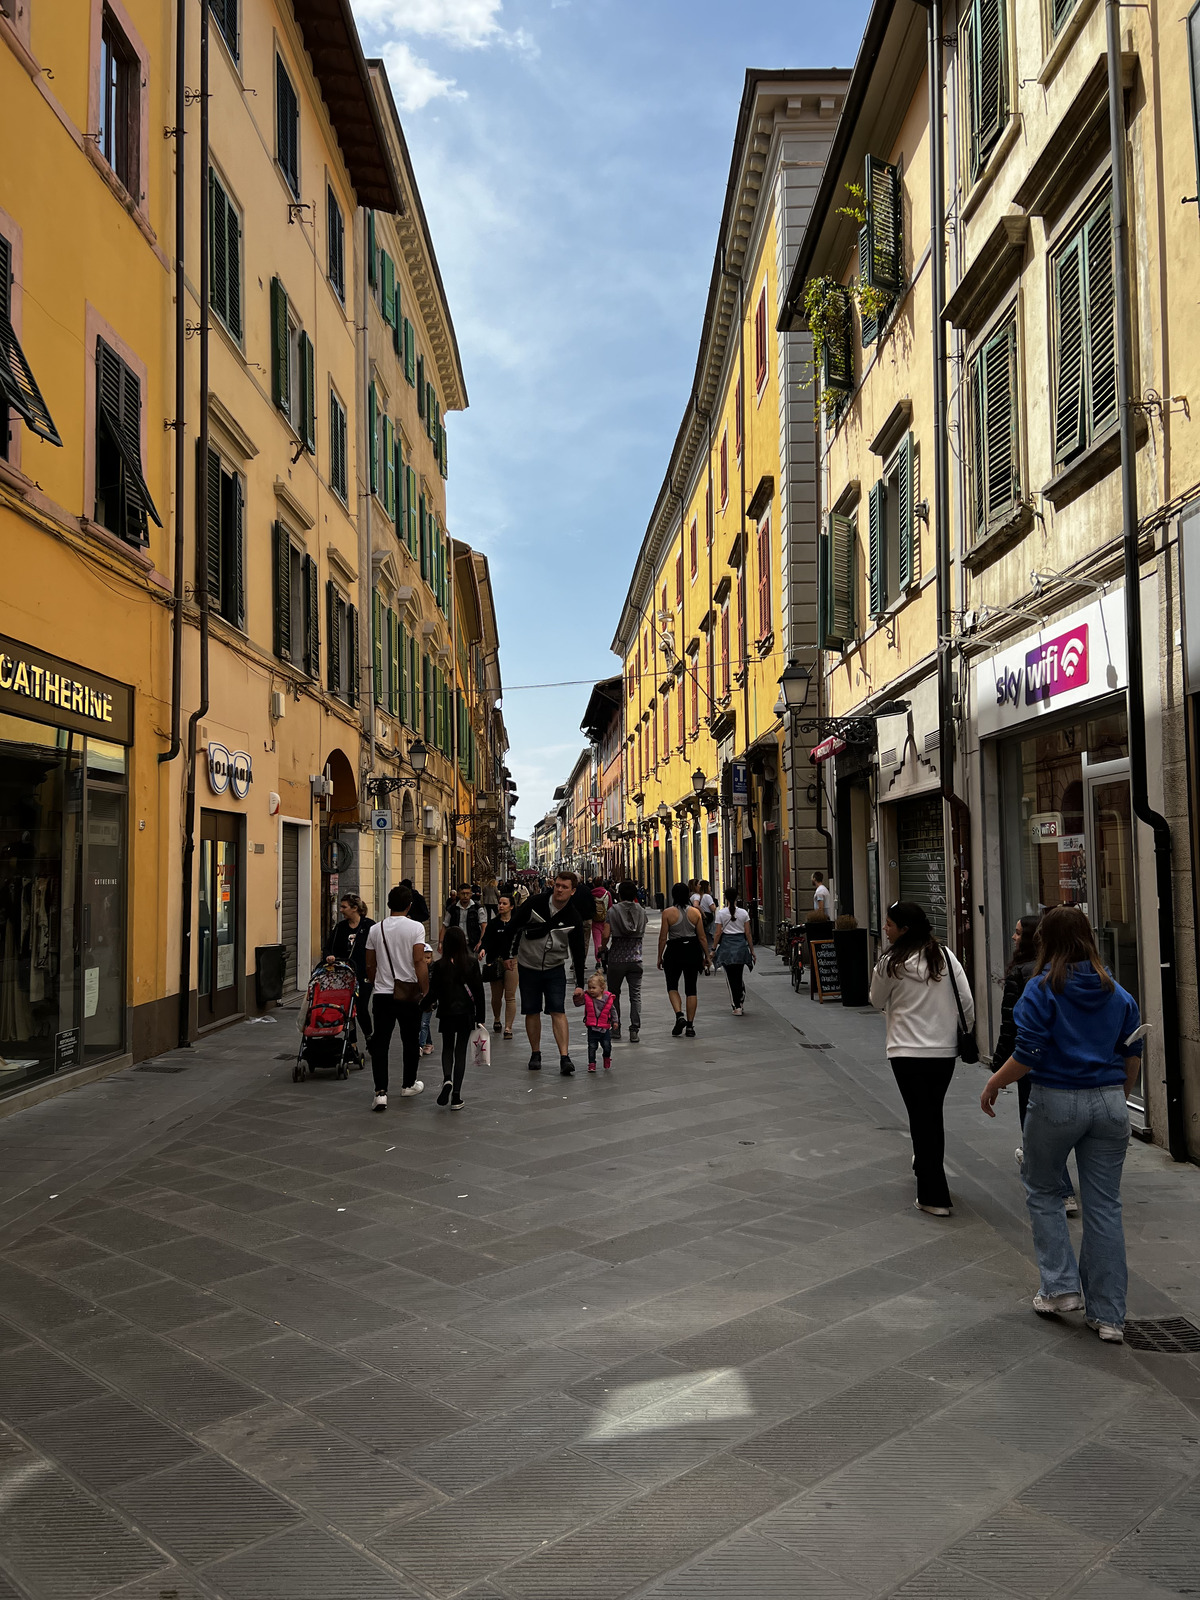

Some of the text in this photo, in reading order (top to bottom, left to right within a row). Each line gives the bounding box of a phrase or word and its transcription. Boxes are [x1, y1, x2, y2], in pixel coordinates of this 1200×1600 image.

[0, 653, 112, 722] CATHERINE
[996, 645, 1058, 706] sky wifi
